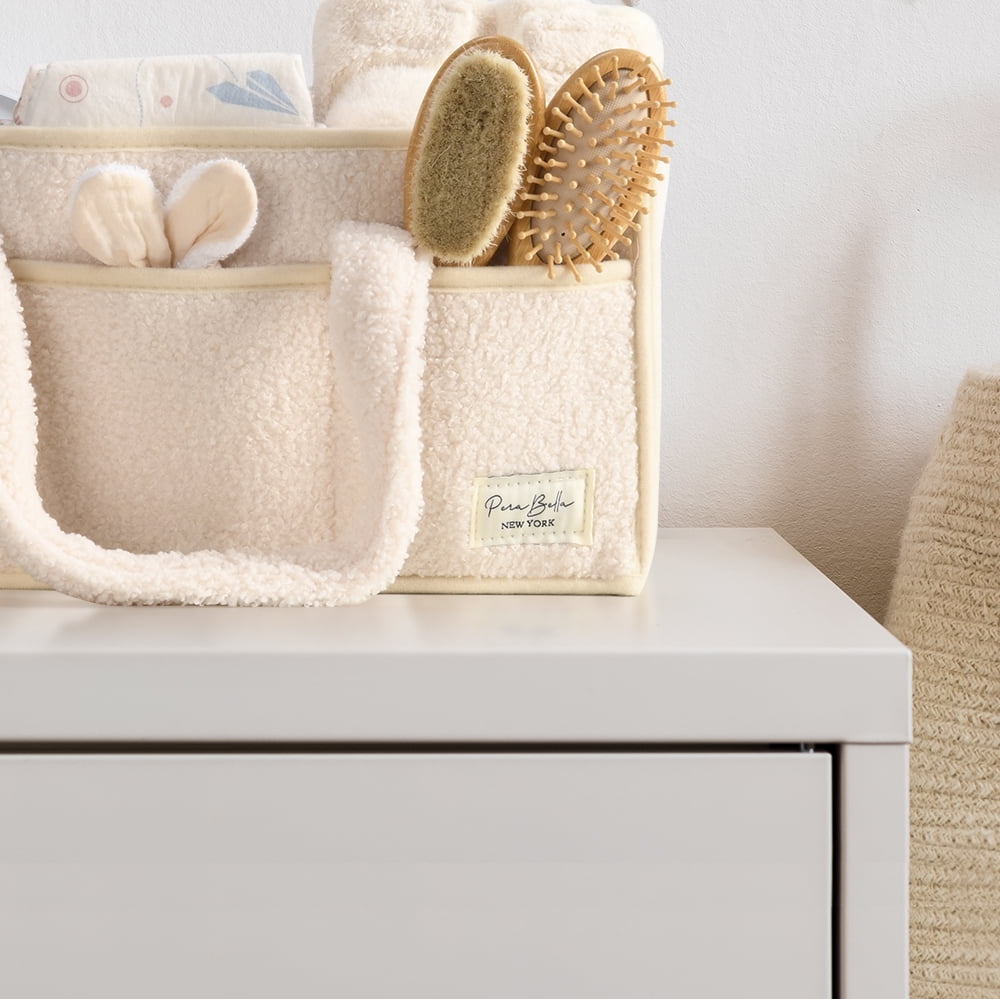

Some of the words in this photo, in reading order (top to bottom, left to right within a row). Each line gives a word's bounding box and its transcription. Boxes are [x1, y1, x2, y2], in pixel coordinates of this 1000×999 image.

[485, 495, 529, 517] Pera
[527, 490, 575, 517] Bella
[501, 521, 525, 530] NEW
[526, 519, 555, 527] YORK
